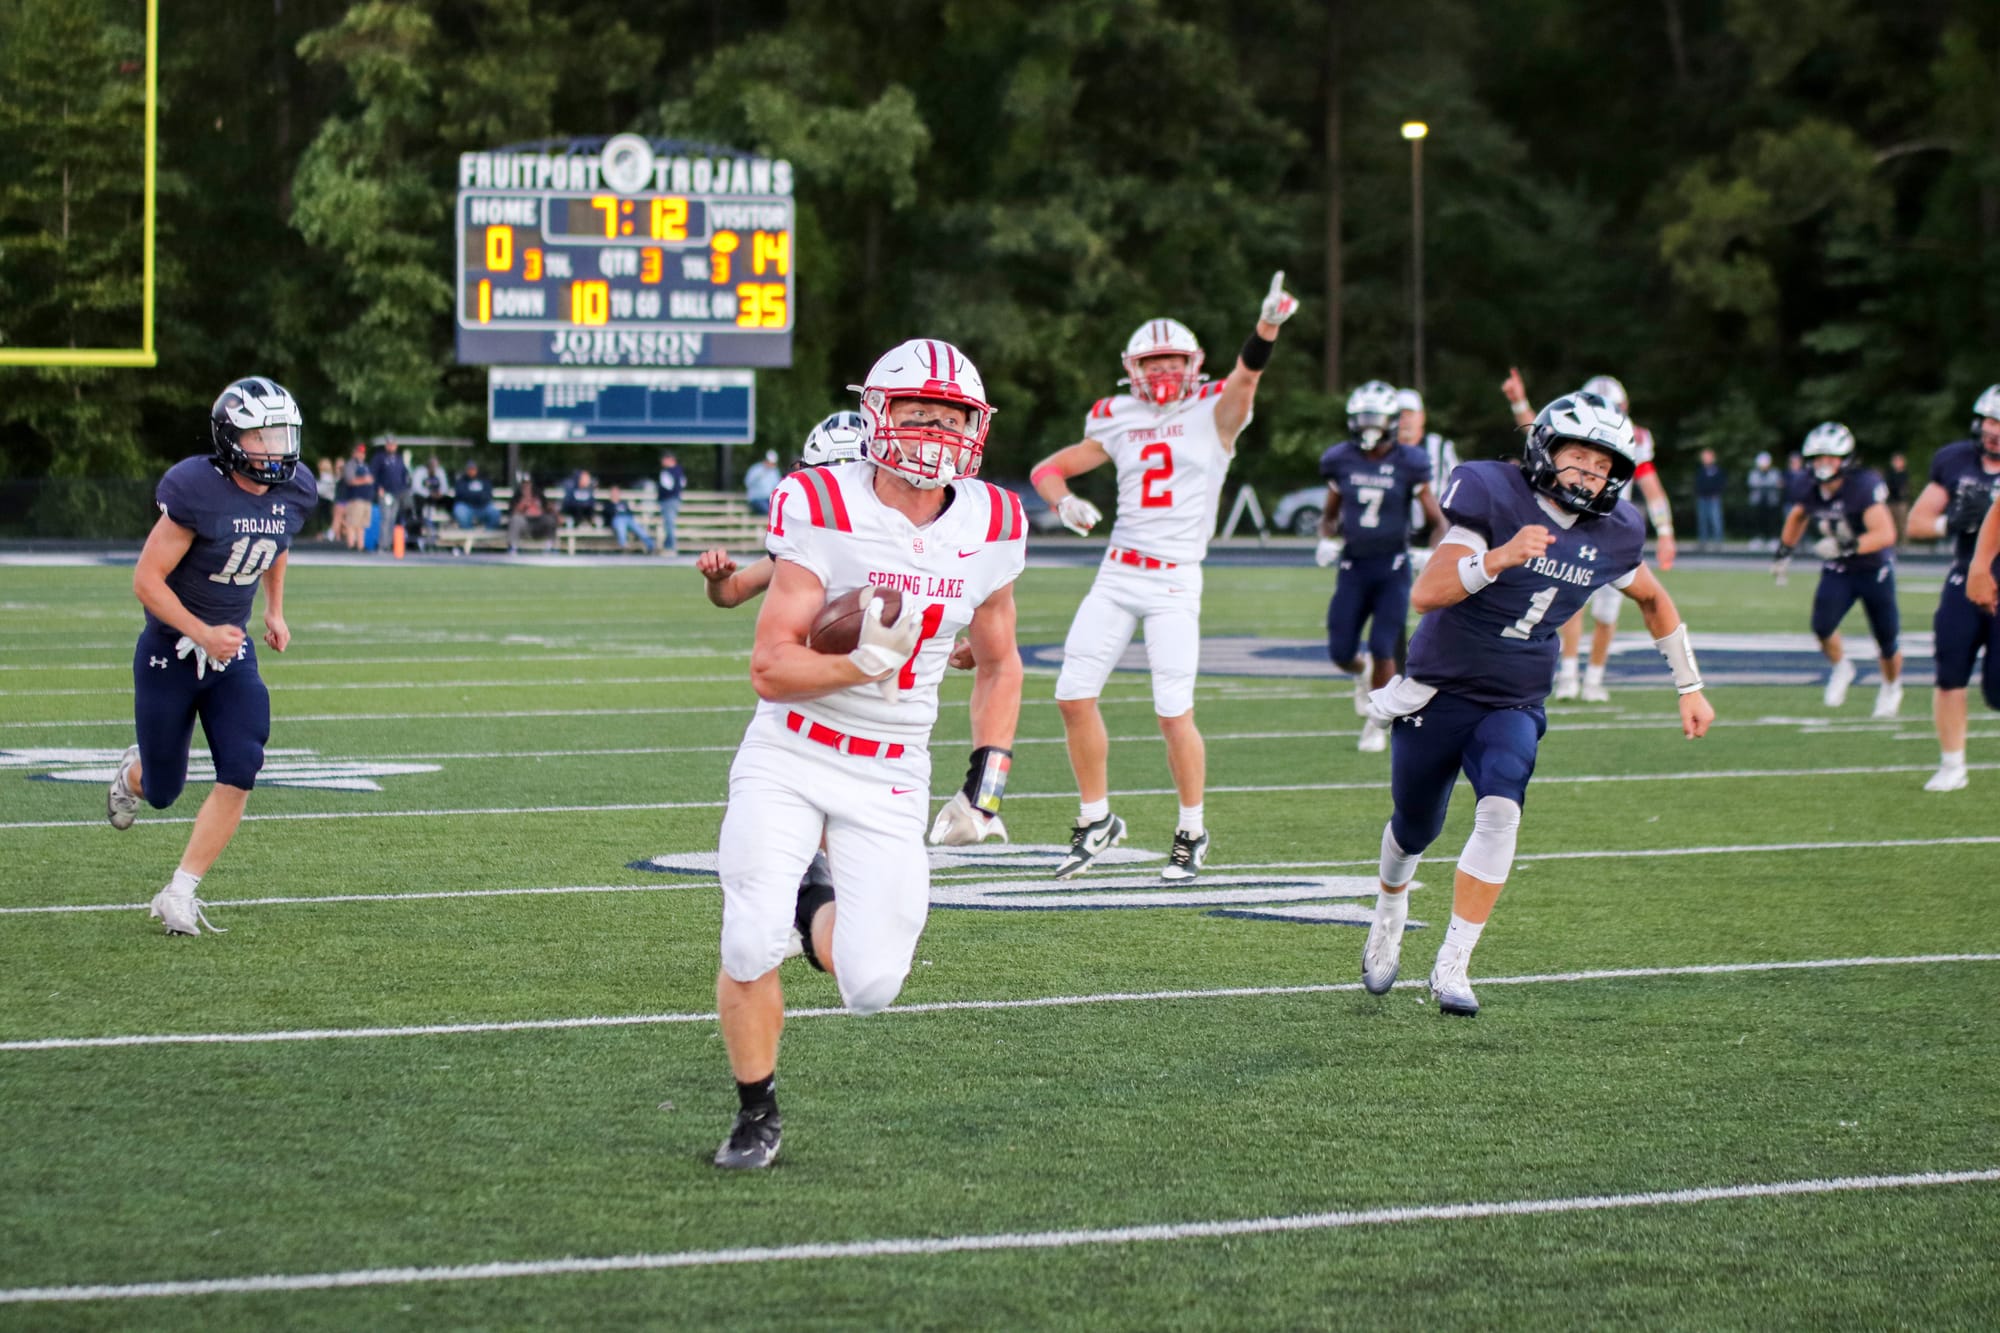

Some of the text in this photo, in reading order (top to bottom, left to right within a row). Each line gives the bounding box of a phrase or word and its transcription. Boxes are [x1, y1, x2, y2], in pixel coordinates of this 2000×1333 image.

[460, 152, 794, 195] FRUITPORT TROJANS
[471, 198, 537, 225] HOME
[591, 194, 688, 241] 7:12
[711, 205, 787, 230] VISITOR
[486, 224, 513, 272] 0
[599, 248, 638, 278] QTR
[752, 230, 790, 276] 14
[478, 279, 491, 325] 1
[492, 289, 545, 317] DOWN
[571, 280, 609, 326] 10
[736, 282, 787, 328] 35
[551, 330, 702, 355] JOHNSON
[1128, 424, 1184, 442] SPRING LAKE
[1140, 442, 1173, 508] 2
[233, 518, 286, 534] TROJANS
[1358, 487, 1384, 528] 7
[209, 536, 278, 586] 10
[868, 571, 964, 598] SPRING LAKE
[1501, 587, 1558, 640] 1
